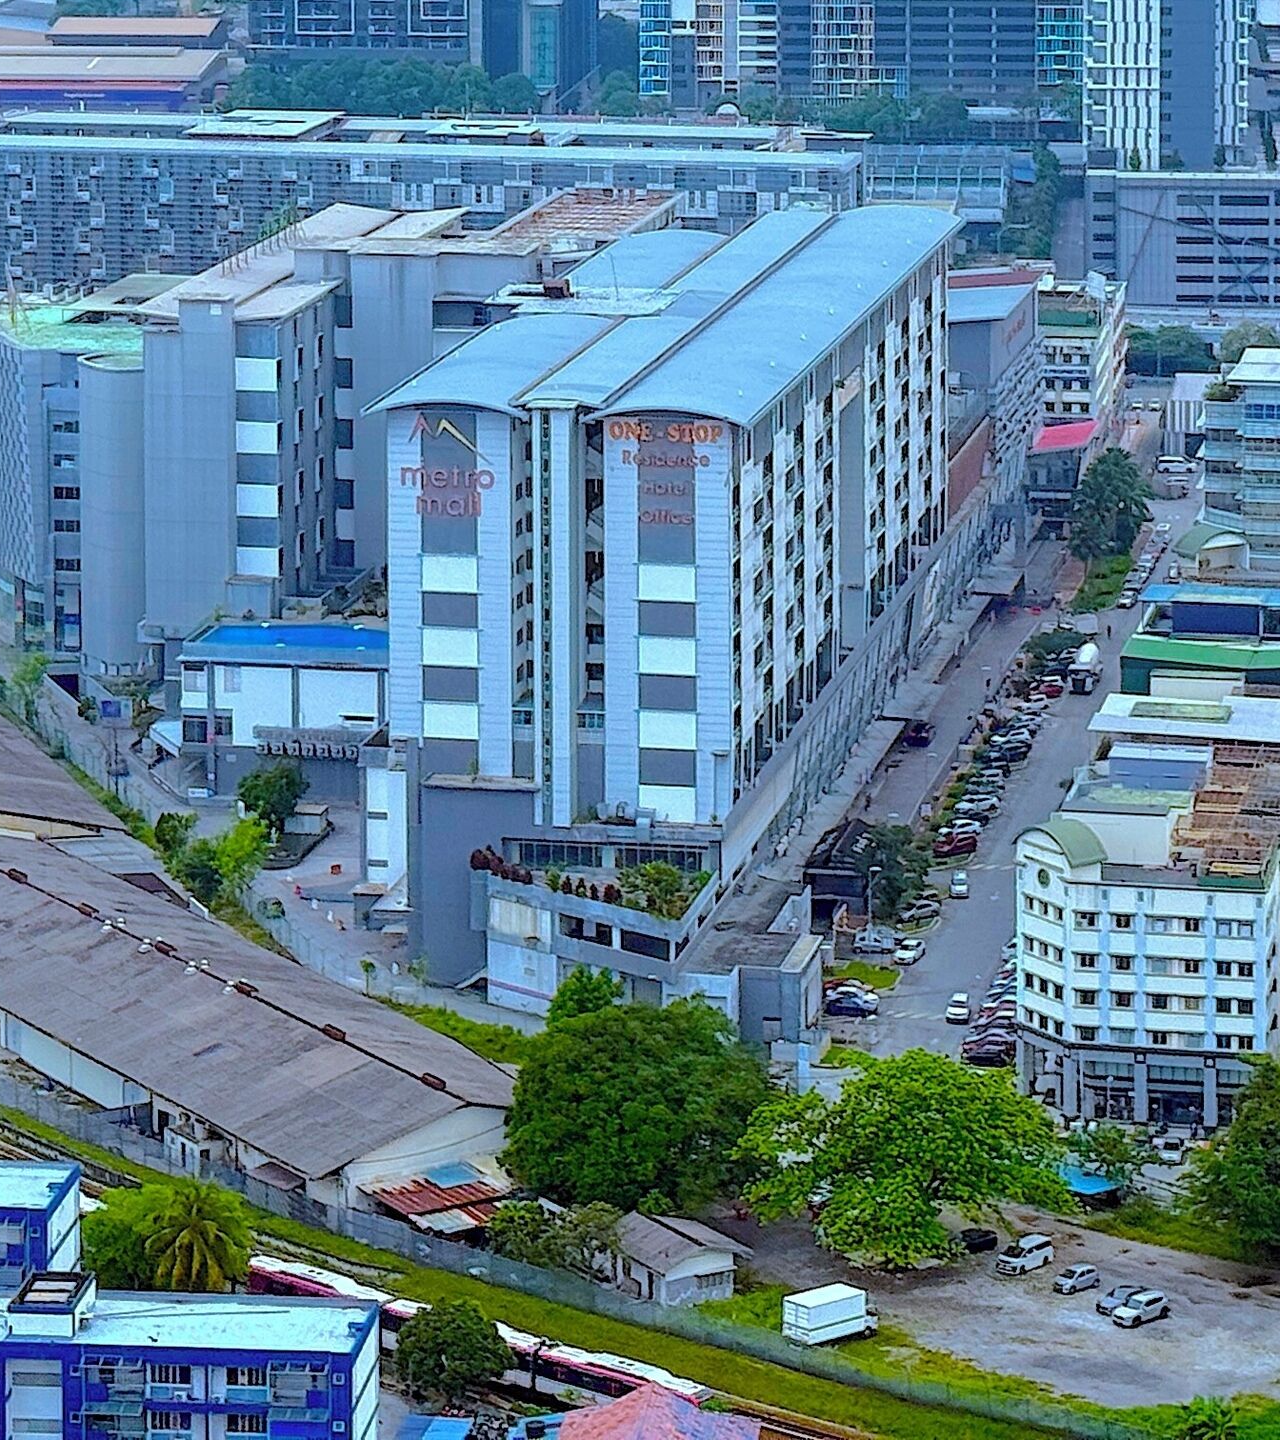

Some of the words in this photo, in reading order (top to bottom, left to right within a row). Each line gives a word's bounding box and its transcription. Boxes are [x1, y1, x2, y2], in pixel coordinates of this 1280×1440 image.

[622, 449, 711, 467] Residence
[400, 464, 496, 489] metro
[644, 481, 689, 496] Hotel
[416, 492, 482, 517] mall
[639, 509, 694, 525] Office
